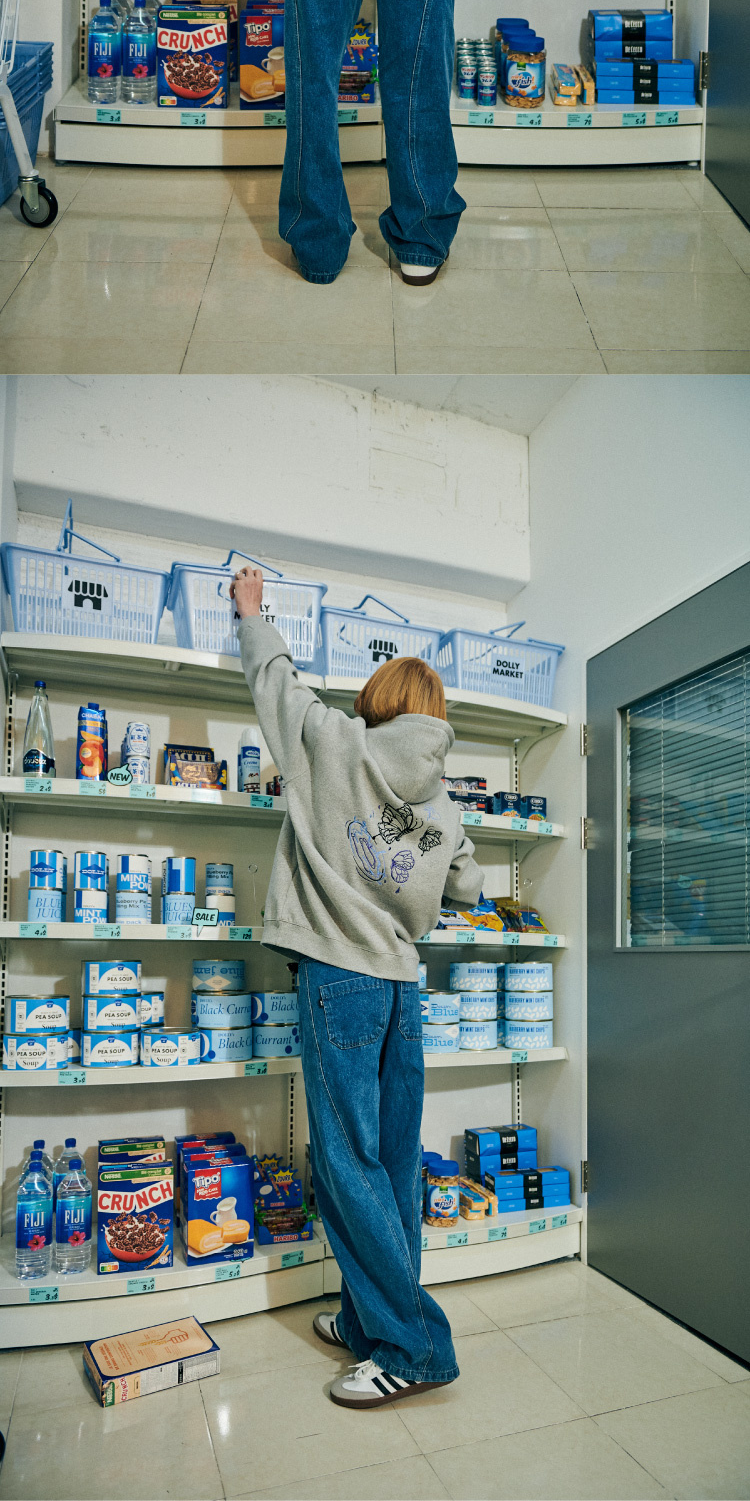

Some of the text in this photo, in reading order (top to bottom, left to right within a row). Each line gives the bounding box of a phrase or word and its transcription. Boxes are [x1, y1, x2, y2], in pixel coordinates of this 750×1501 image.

[244, 21, 271, 35] Tipo
[158, 25, 227, 50] CRUNCH
[93, 42, 112, 56] FIJI
[129, 43, 147, 57] FIJI
[234, 611, 276, 624] MET
[496, 659, 520, 670] DOLLY
[492, 667, 524, 680] MARKET
[109, 772, 130, 782] NEW
[120, 874, 147, 883] MINT
[75, 909, 102, 918] MINT
[195, 912, 215, 922] SALE
[200, 1004, 225, 1015] Black
[271, 1001, 295, 1012] Black
[218, 1038, 244, 1049] Black
[255, 1034, 292, 1046] Currant
[193, 1172, 221, 1188] Tipo
[98, 1181, 173, 1212] CRUNCH
[24, 1211, 45, 1229] FIJI
[64, 1208, 85, 1225] FIJI
[273, 1235, 299, 1243] HARIBO
